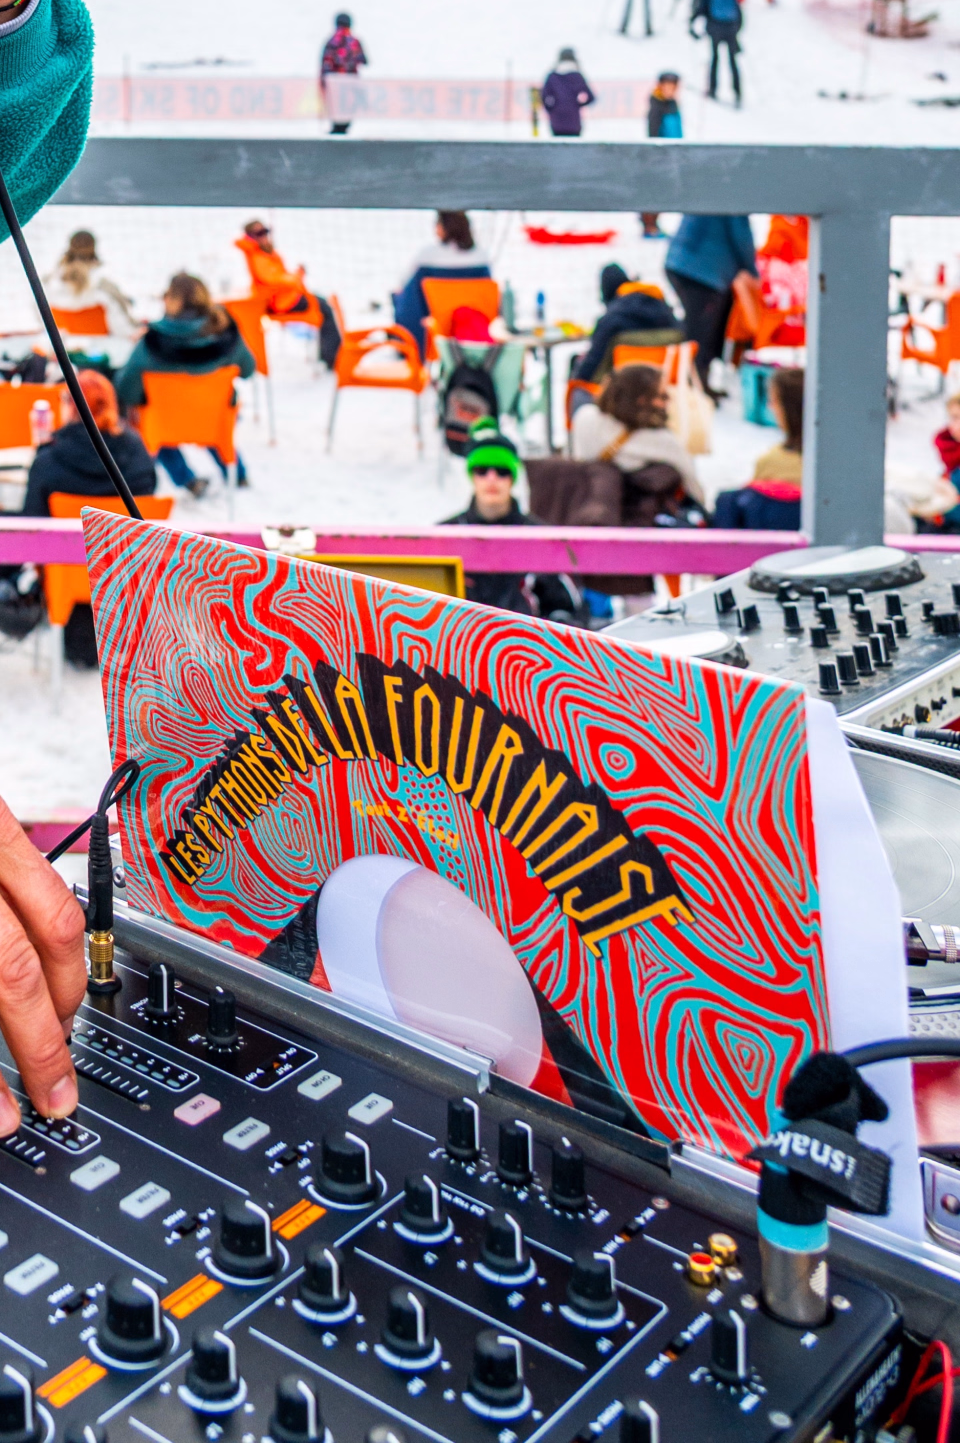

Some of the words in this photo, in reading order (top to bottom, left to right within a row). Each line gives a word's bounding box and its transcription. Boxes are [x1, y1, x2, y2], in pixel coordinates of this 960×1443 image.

[169, 833, 211, 886] LES
[193, 734, 292, 854] PYTHONS
[266, 698, 330, 775] DE
[304, 673, 379, 762] LA
[383, 674, 697, 959] FOURNAISE
[352, 799, 393, 819] Tout
[189, 1099, 206, 1112] CUE
[363, 1099, 379, 1111] CUE
[235, 1122, 259, 1140] FILTER
